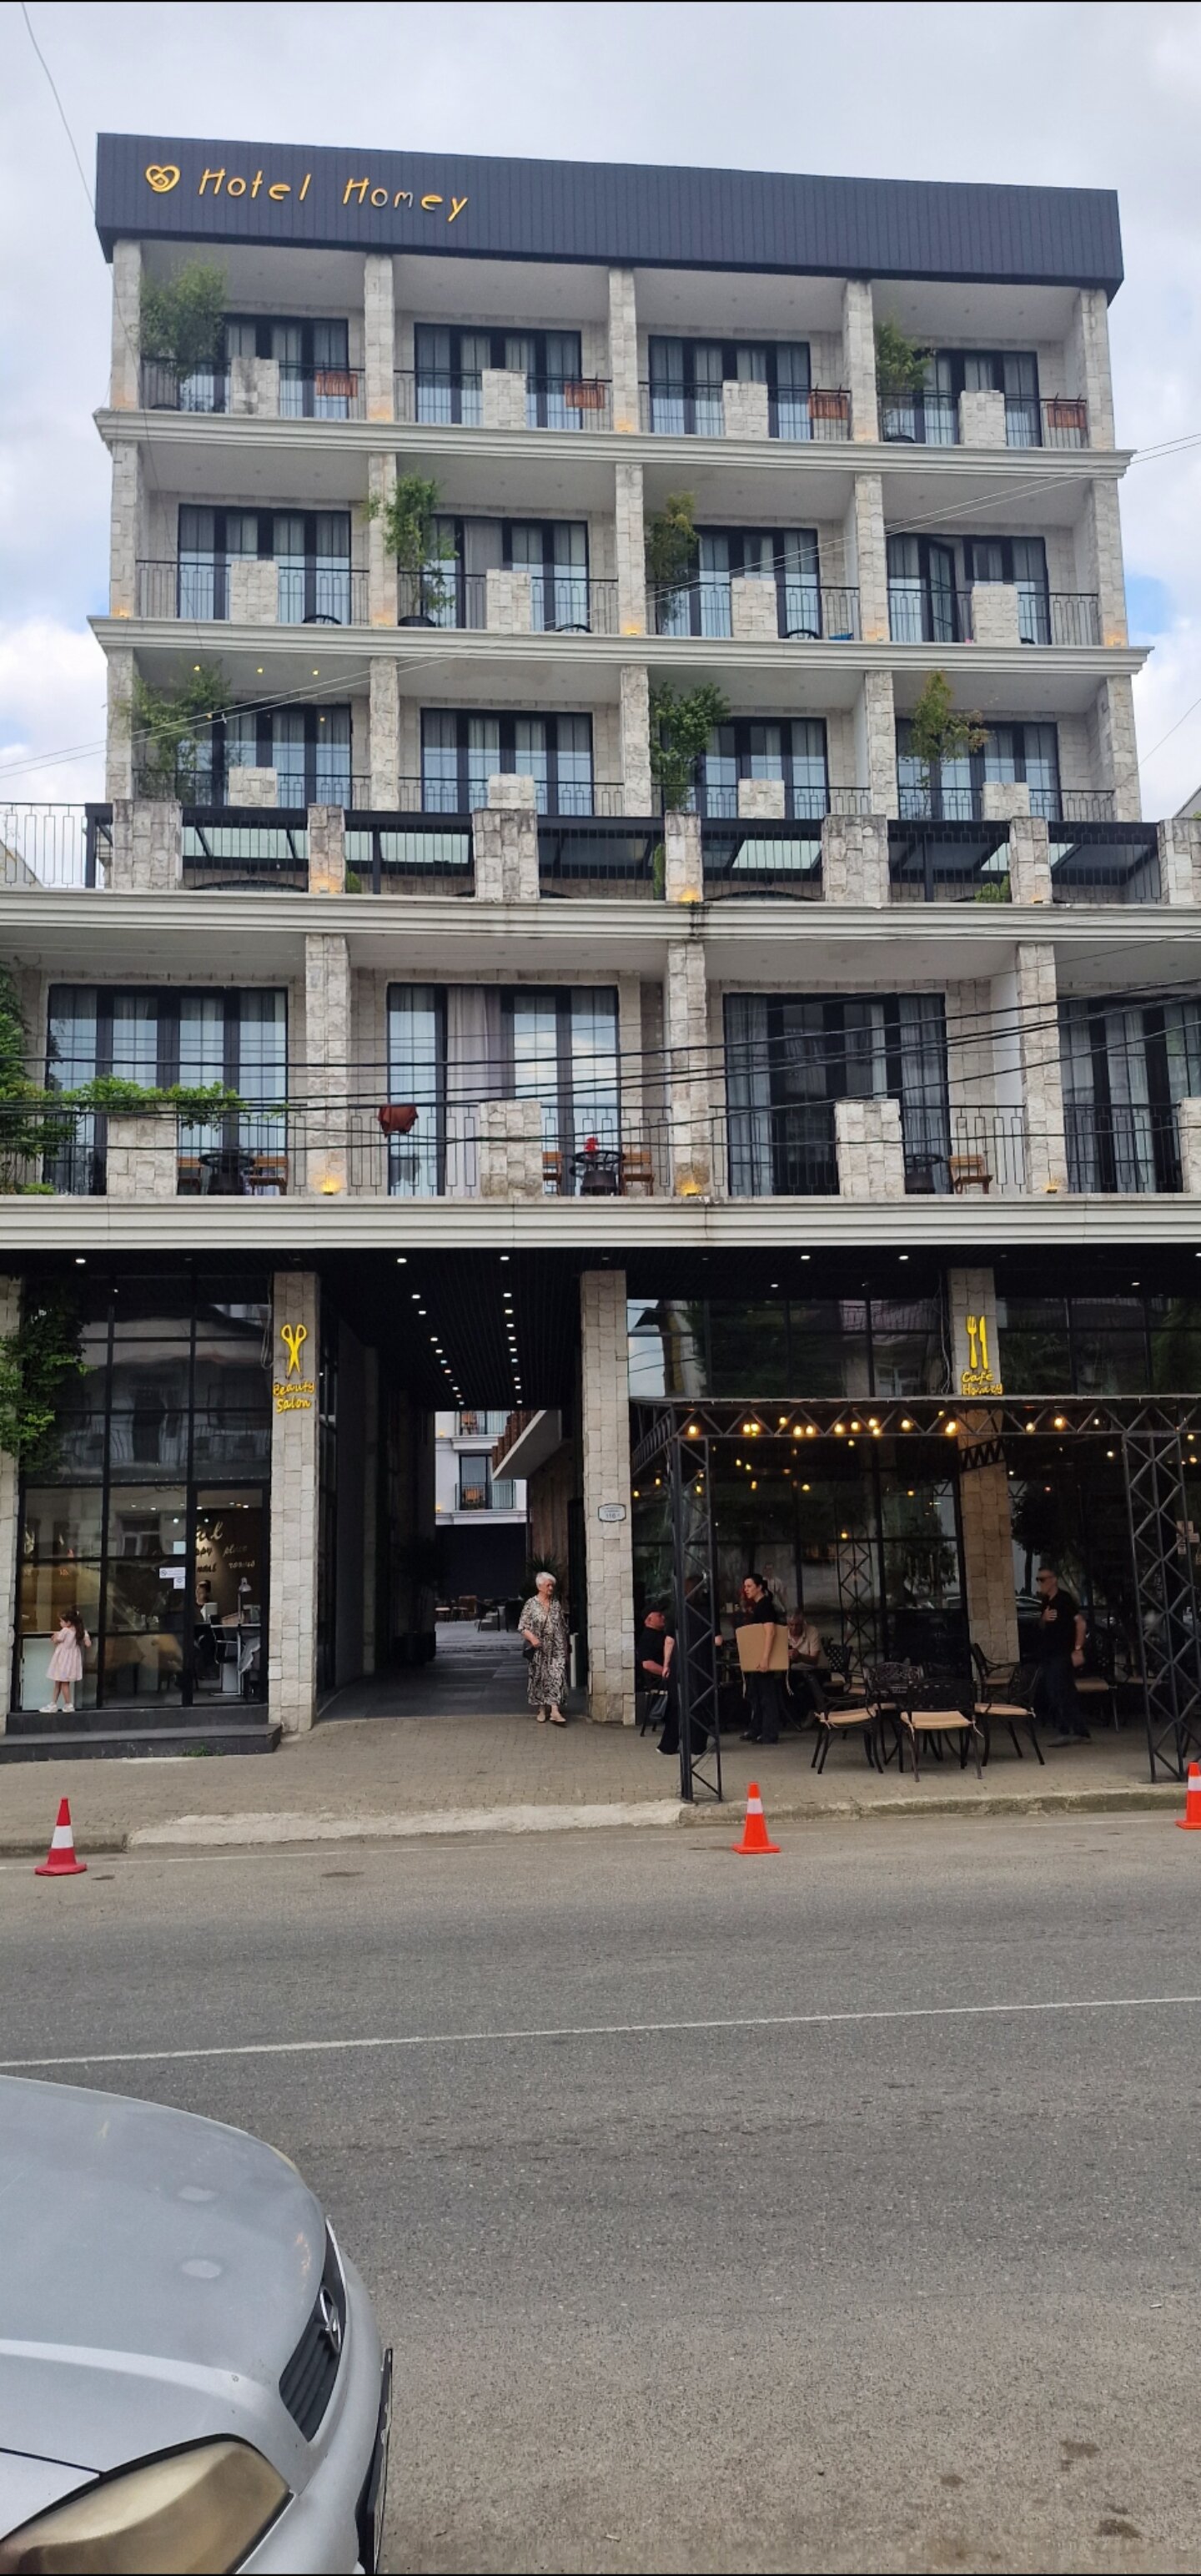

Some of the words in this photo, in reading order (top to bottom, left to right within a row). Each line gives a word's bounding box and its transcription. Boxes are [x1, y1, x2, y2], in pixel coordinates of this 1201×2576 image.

[198, 168, 312, 201] Hotel
[342, 177, 469, 223] Homey
[273, 1381, 314, 1396] Beauty
[276, 1398, 311, 1414] Salon
